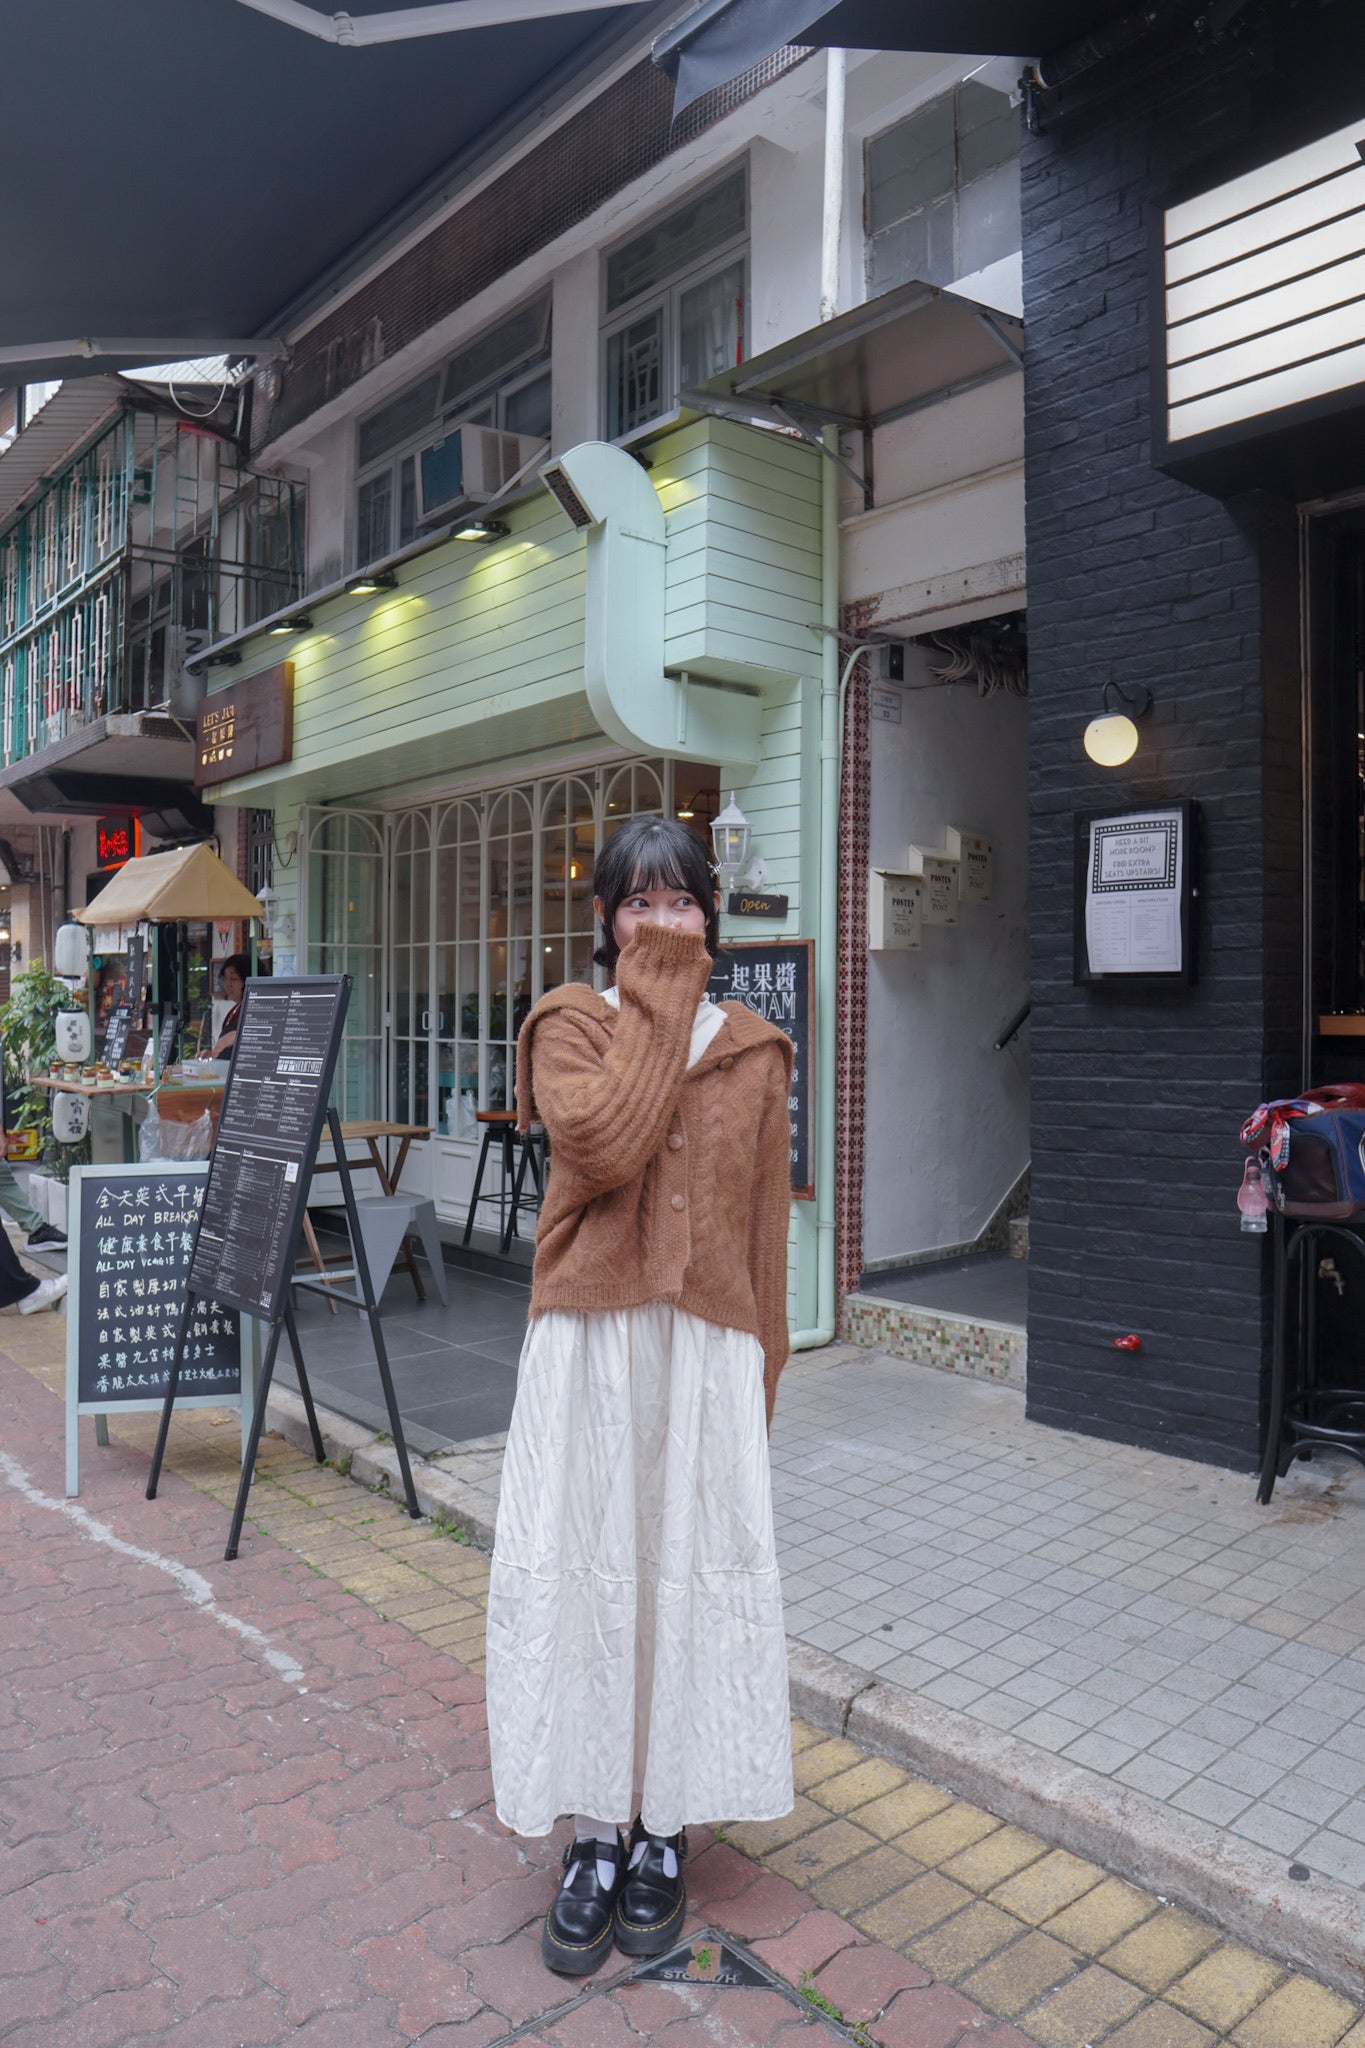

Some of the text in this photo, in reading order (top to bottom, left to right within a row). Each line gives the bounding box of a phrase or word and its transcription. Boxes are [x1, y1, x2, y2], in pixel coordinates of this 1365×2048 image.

[740, 898, 771, 913] Open
[710, 962, 797, 992] 一起果醬
[95, 1214, 115, 1230] ALL
[123, 1213, 146, 1227] DAY
[97, 1231, 194, 1256] 健康素食早餐
[96, 1259, 115, 1273] ALL
[116, 1259, 136, 1271] DAY
